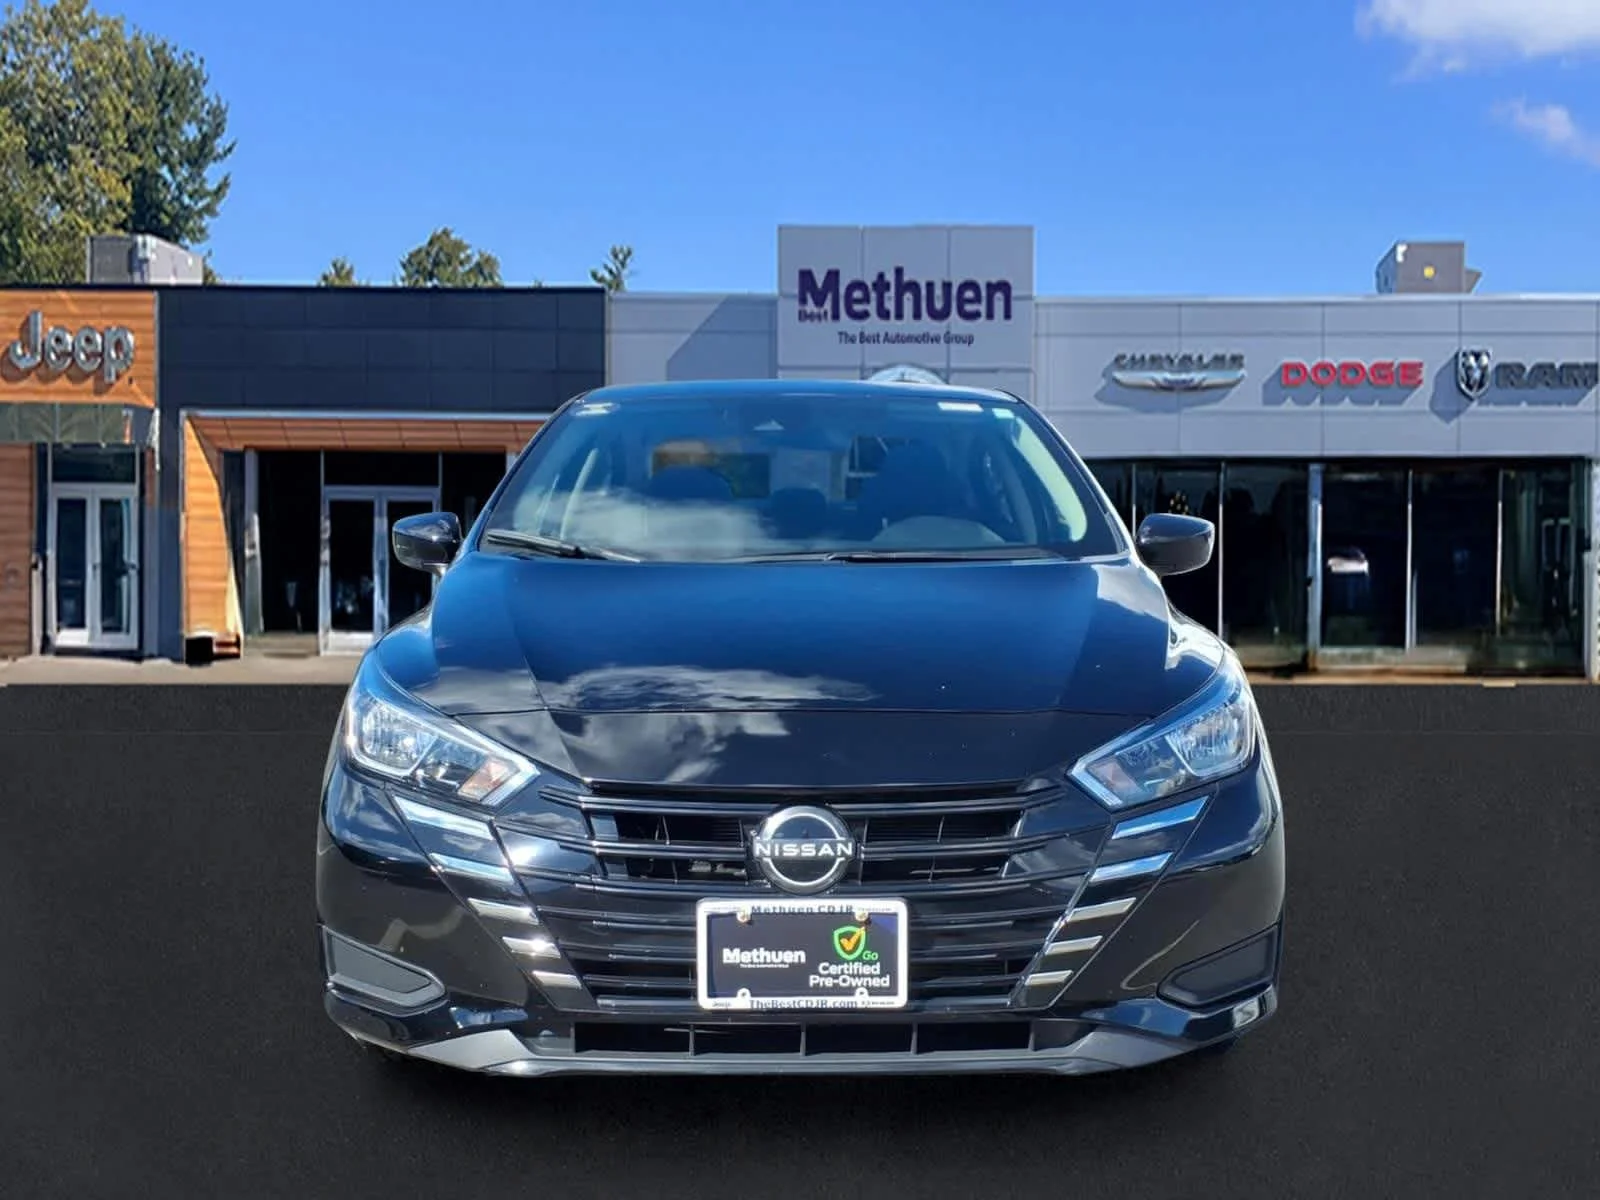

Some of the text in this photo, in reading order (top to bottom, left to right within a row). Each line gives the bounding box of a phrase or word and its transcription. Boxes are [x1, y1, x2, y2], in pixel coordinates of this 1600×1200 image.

[798, 266, 1012, 322] Methuen
[838, 331, 974, 346] The Best Automotive Group
[10, 310, 135, 384] Jeep
[1282, 361, 1423, 387] DODGE
[1496, 361, 1599, 389] RAM
[755, 842, 853, 857] NISSAN
[751, 905, 814, 914] Methuen
[723, 947, 806, 964] Methuen
[862, 951, 878, 961] Go
[818, 962, 881, 976] Certified
[809, 975, 890, 988] Pre-Owned
[750, 999, 858, 1009] TheBestCDJR.com
